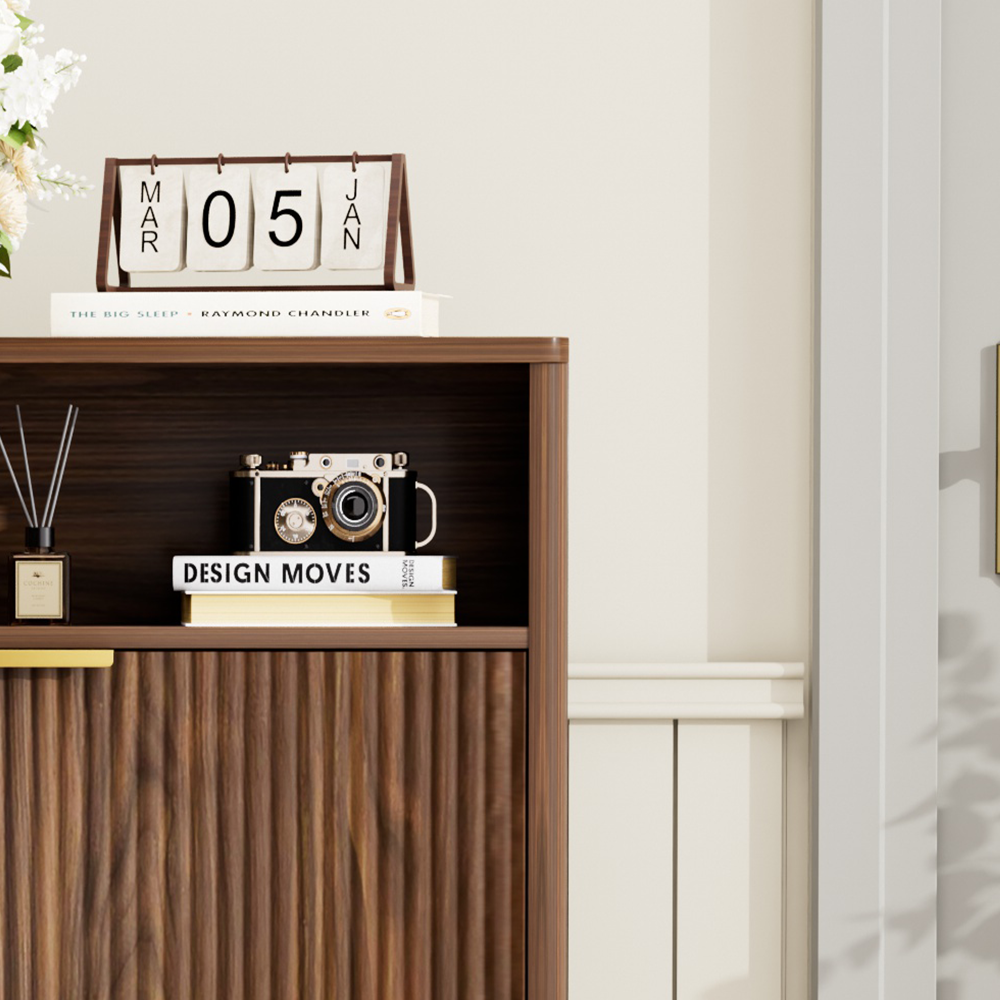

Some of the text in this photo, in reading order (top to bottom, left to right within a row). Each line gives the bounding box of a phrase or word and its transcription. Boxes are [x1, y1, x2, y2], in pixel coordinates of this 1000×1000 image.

[140, 180, 161, 253] MAR
[268, 189, 304, 248] 5
[342, 178, 362, 250] JAN
[70, 309, 371, 319] THE BIG SLEEP RAYMOND CHANDLER
[183, 562, 371, 584] DESIGN MOVES
